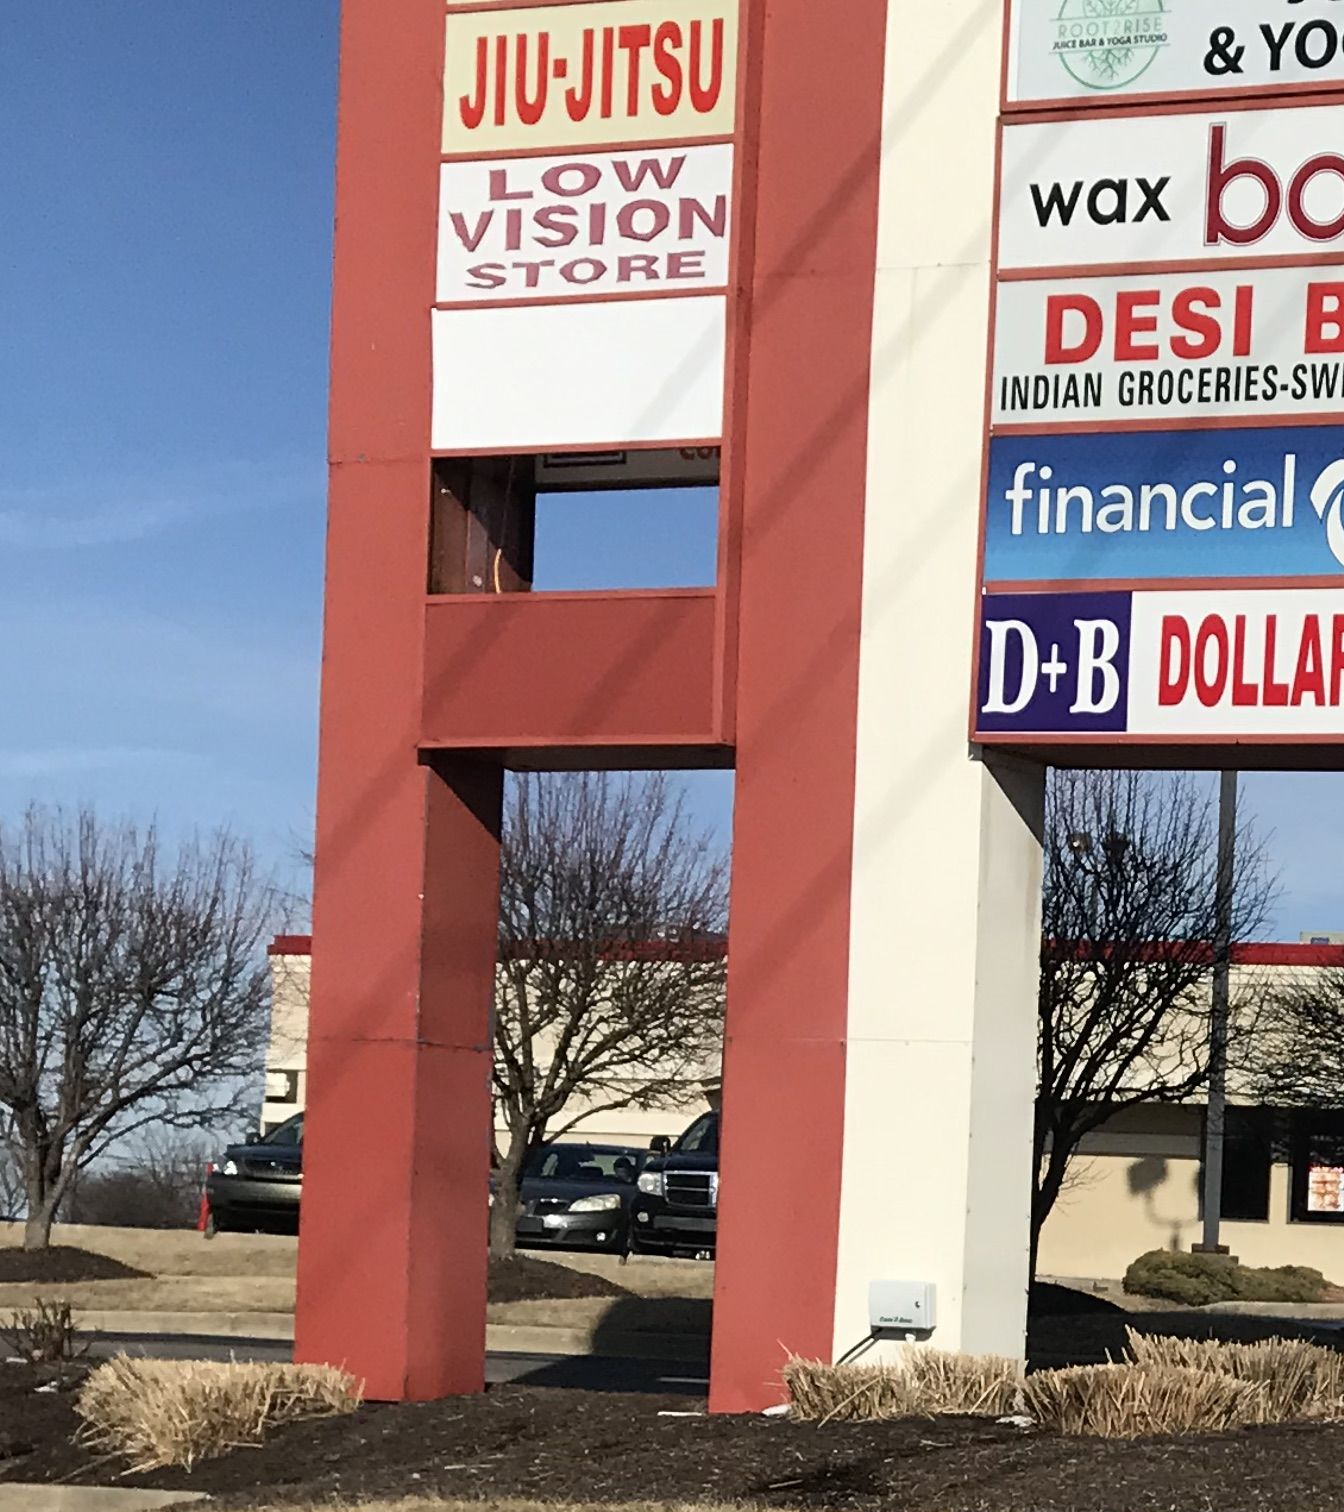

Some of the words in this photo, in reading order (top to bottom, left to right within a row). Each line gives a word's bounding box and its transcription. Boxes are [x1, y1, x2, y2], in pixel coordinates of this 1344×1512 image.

[1079, 37, 1096, 48] BAR
[1107, 35, 1132, 46] YOGA
[1133, 33, 1168, 44] STUDIO
[1203, 26, 1245, 76] &
[458, 18, 724, 130] JIU-JITSU
[490, 155, 687, 200] LOW
[1029, 175, 1171, 227] wax
[448, 195, 727, 252] VISION
[466, 250, 706, 289] STORE
[1045, 285, 1253, 364] DESI
[1000, 373, 1102, 411] INDIAN
[1005, 454, 1296, 535] financial
[981, 618, 1122, 716] D+B
